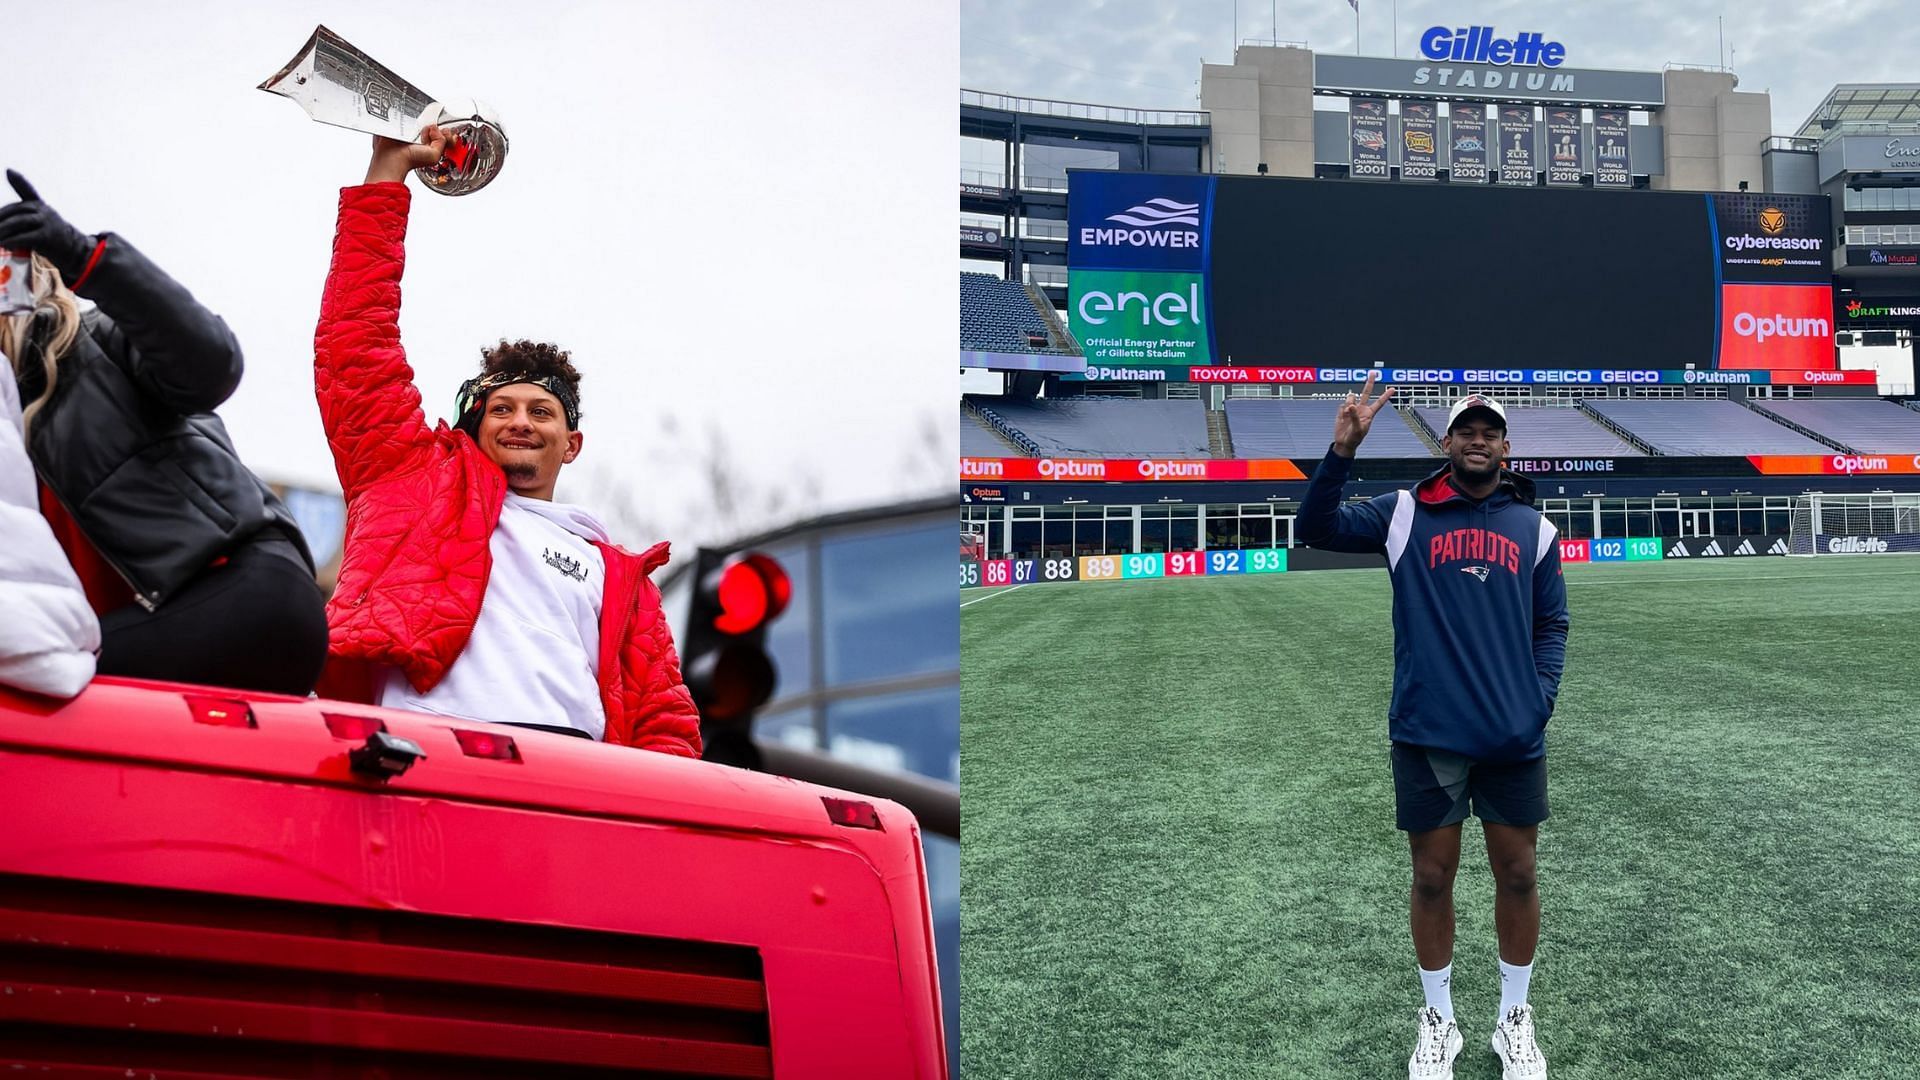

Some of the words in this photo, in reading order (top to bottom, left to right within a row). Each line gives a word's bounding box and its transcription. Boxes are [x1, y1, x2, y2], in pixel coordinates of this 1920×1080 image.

[1420, 26, 1566, 67] Gillette
[1413, 67, 1575, 92] STADIUM
[1355, 165, 1385, 174] 2001
[1404, 167, 1436, 176] 2003
[1454, 168, 1485, 177] 2004
[1504, 171, 1532, 179] 2014
[1552, 173, 1580, 182] 2016
[1600, 174, 1626, 182] 2018
[1081, 228, 1199, 248] EMPOWER
[1726, 234, 1821, 251] cybereason
[1079, 283, 1200, 326] enel
[1734, 312, 1828, 343] Optum
[1086, 338, 1122, 347] Official
[1125, 339, 1158, 350] Energy
[1160, 339, 1196, 348] Partner
[1109, 350, 1144, 358] Gillette
[1147, 350, 1186, 358] Stadium
[1101, 367, 1165, 381] Putnam
[1192, 369, 1248, 380] TOYOTA
[1258, 369, 1314, 380] TOYOTA
[1320, 369, 1382, 382] GEICO
[1392, 370, 1454, 382] GEICO
[1463, 370, 1523, 382] GEICO
[1533, 371, 1592, 382] GEICO
[1601, 371, 1659, 383] GEICO
[1697, 371, 1751, 384] Putnam
[1804, 371, 1844, 383] Optum
[960, 459, 1003, 475] tum
[1038, 459, 1105, 480] Optum
[1138, 460, 1206, 480] Optum
[1511, 460, 1551, 472] FIELD
[1555, 460, 1614, 472] LOUNGE
[1833, 455, 1888, 474] Optum
[973, 488, 1001, 498] Optum
[1430, 528, 1521, 575] PATRIOTS
[1559, 543, 1584, 558] 101
[1594, 543, 1621, 557] 102
[1631, 542, 1658, 556] 103
[1829, 535, 1888, 553] Gillette
[1087, 556, 1115, 577] 89
[1129, 555, 1157, 576] 90
[1171, 554, 1197, 573] 91
[1212, 553, 1239, 572] 92
[1253, 551, 1280, 570] 93
[960, 563, 978, 585] 85
[988, 562, 1007, 583] 86
[1015, 561, 1033, 581] 87
[1044, 559, 1072, 580] 88
